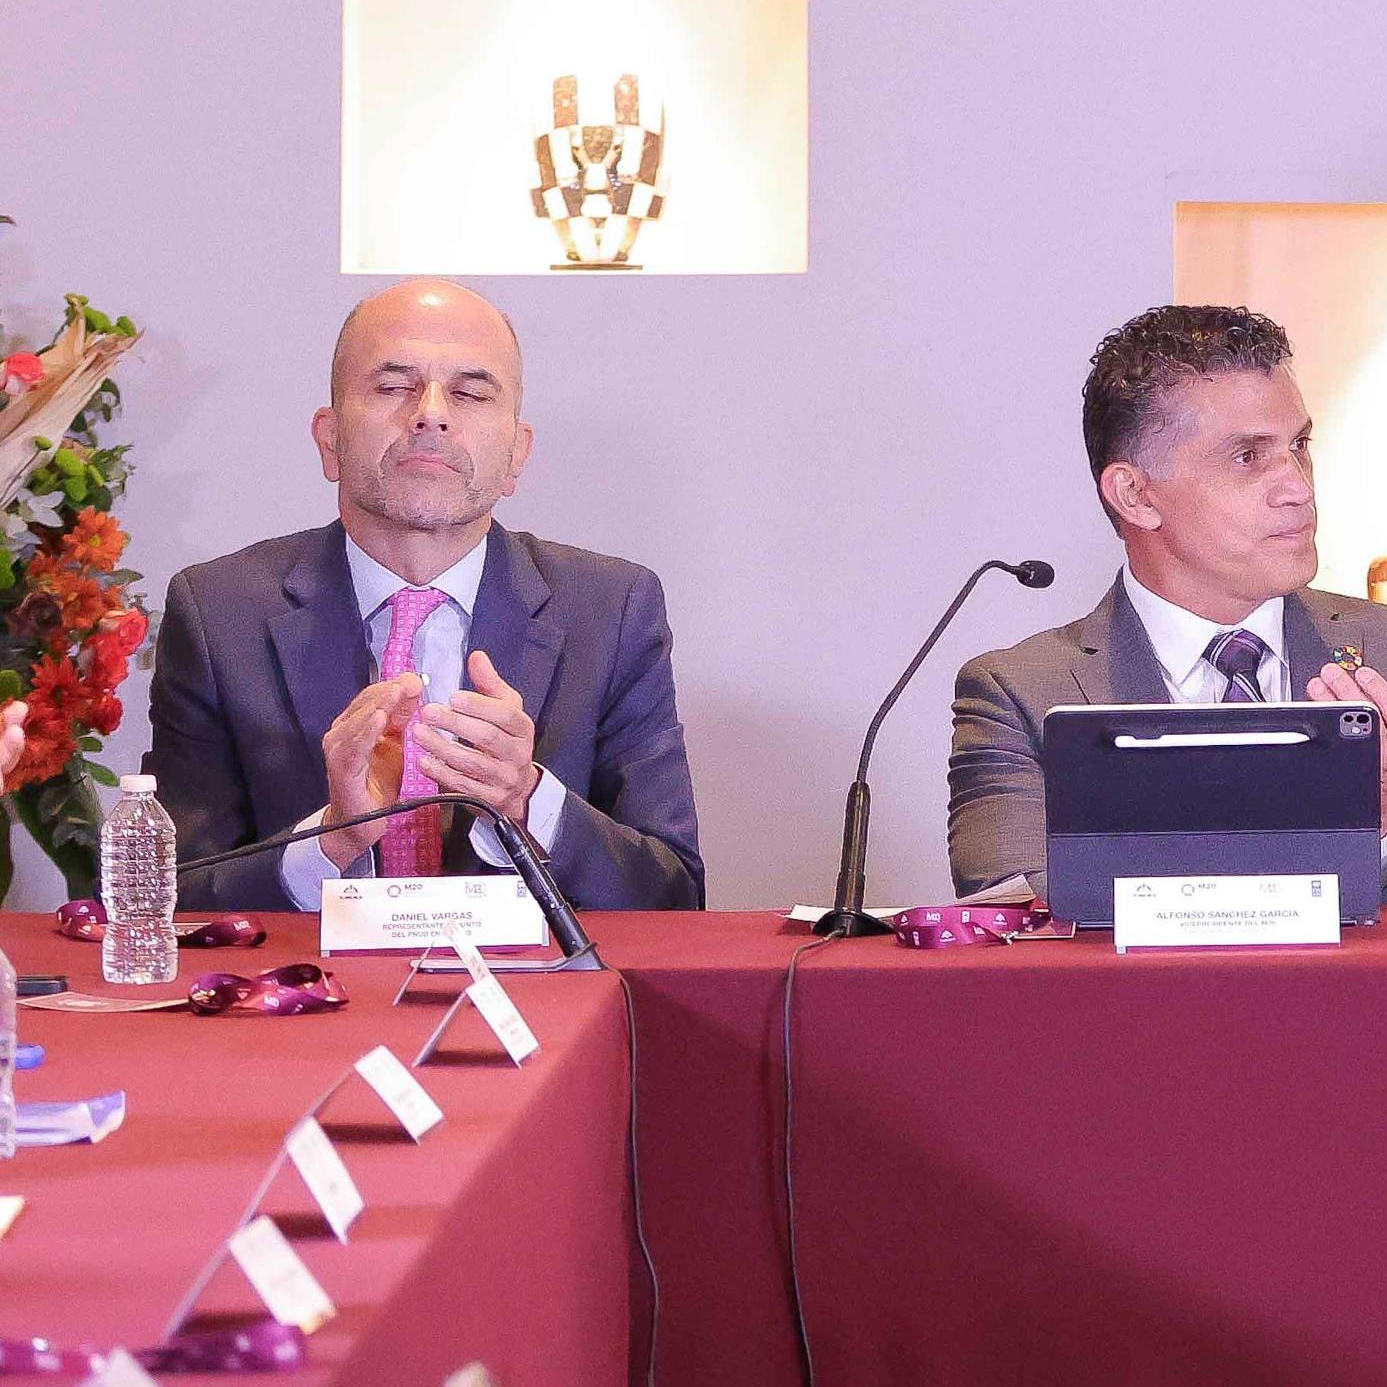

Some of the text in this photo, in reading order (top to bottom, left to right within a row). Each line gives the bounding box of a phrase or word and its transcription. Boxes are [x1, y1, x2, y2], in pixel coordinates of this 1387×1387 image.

[391, 911, 472, 922] DANIEL VARGAS
[1156, 910, 1206, 920] ALFONSO
